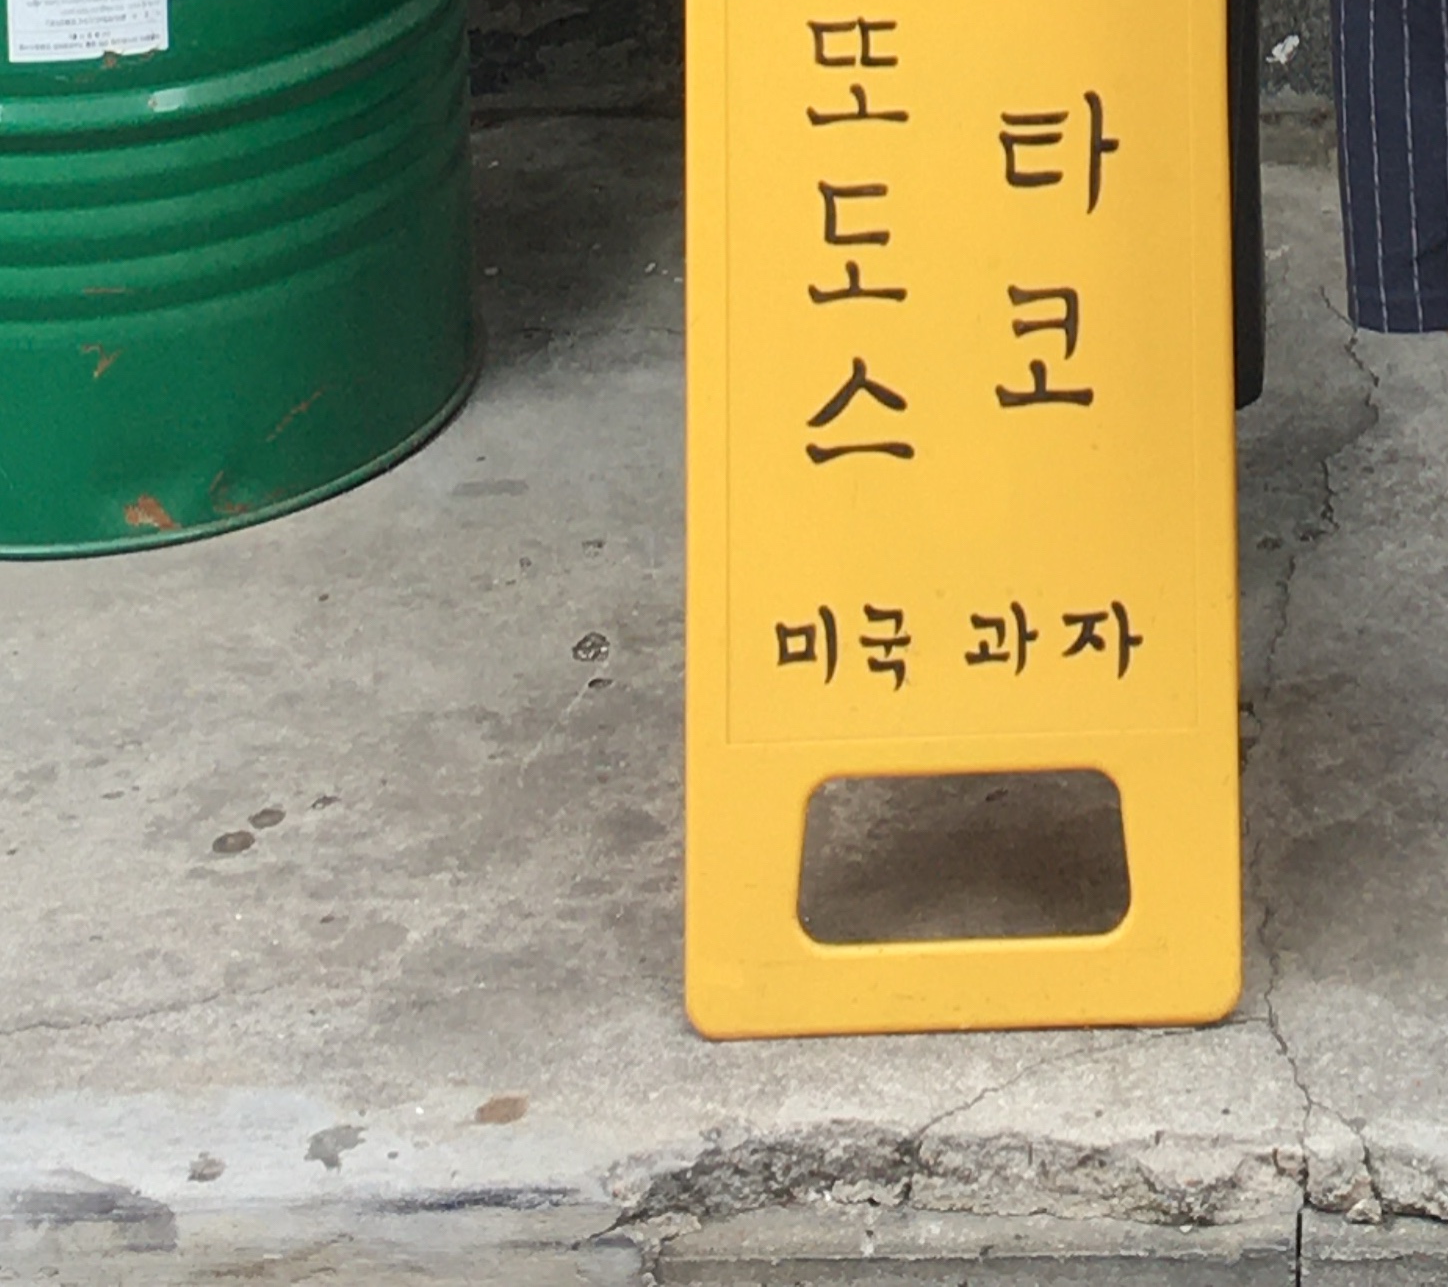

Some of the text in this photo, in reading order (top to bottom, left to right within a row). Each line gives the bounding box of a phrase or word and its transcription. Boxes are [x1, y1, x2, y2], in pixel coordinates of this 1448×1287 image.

[806, 19, 914, 463] 또도스
[996, 92, 1119, 407] 타코
[776, 602, 1142, 689] 미국 과자
